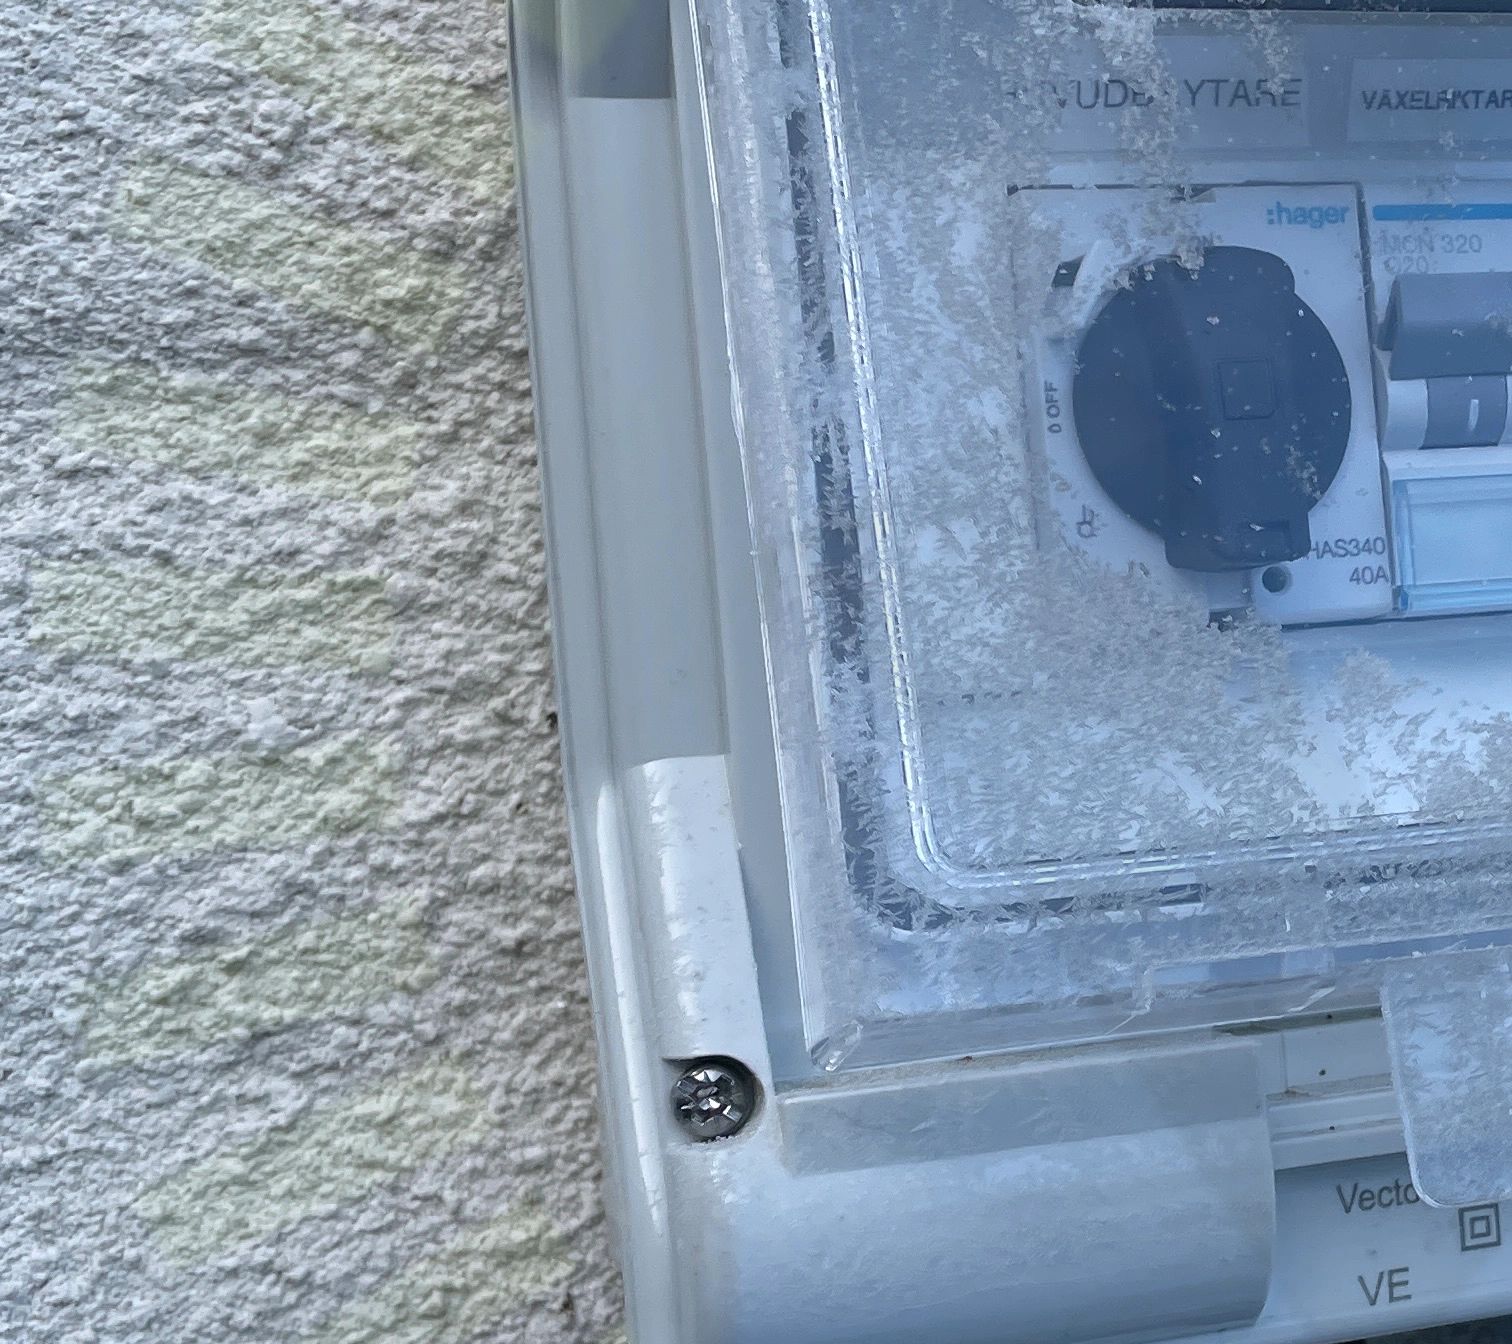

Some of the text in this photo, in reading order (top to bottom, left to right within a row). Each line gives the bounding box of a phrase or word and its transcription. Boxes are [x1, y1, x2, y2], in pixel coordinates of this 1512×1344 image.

[1440, 232, 1483, 255] 320
[1043, 380, 1061, 419] OFF
[1348, 564, 1390, 586] 40A
[1357, 1265, 1413, 1307] VE
